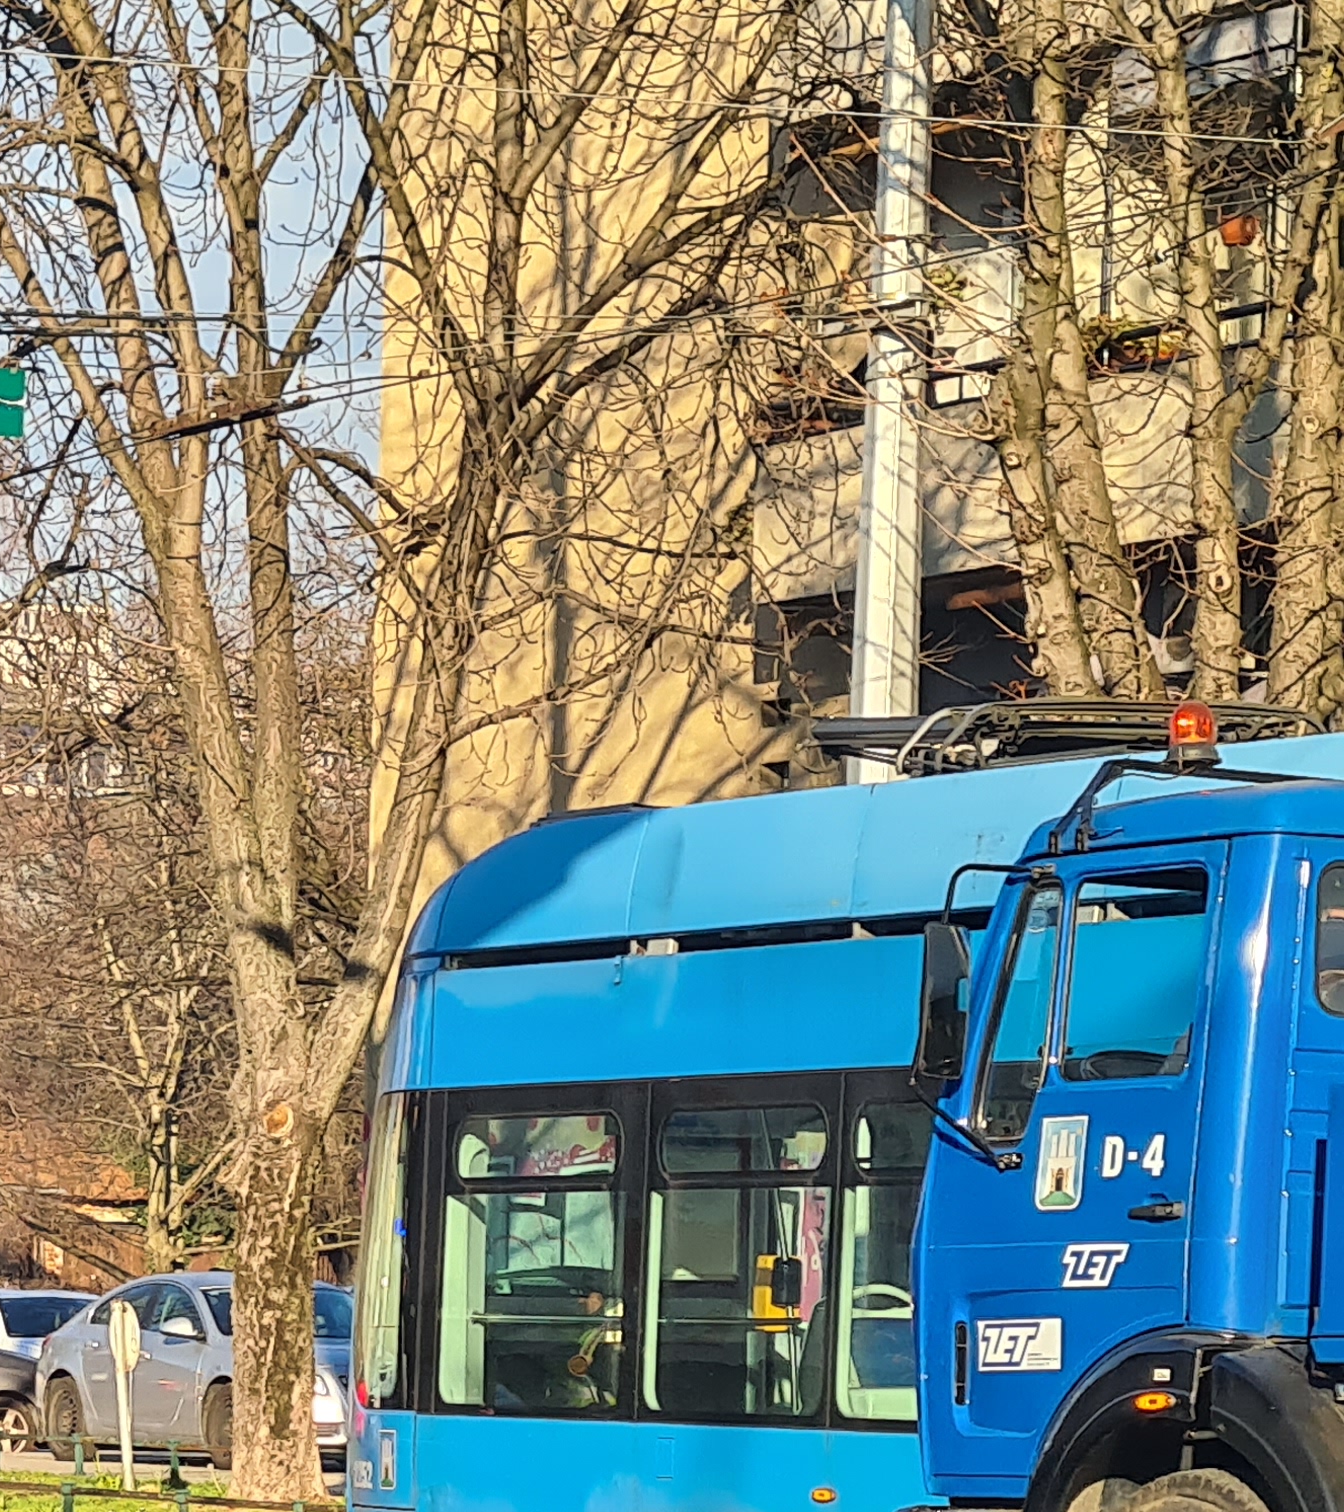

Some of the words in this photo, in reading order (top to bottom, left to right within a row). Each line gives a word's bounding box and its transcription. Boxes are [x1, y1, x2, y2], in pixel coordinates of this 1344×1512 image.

[1101, 1134, 1166, 1178] D-4
[1066, 1246, 1127, 1284] ZET
[981, 1321, 1041, 1368] ZET
